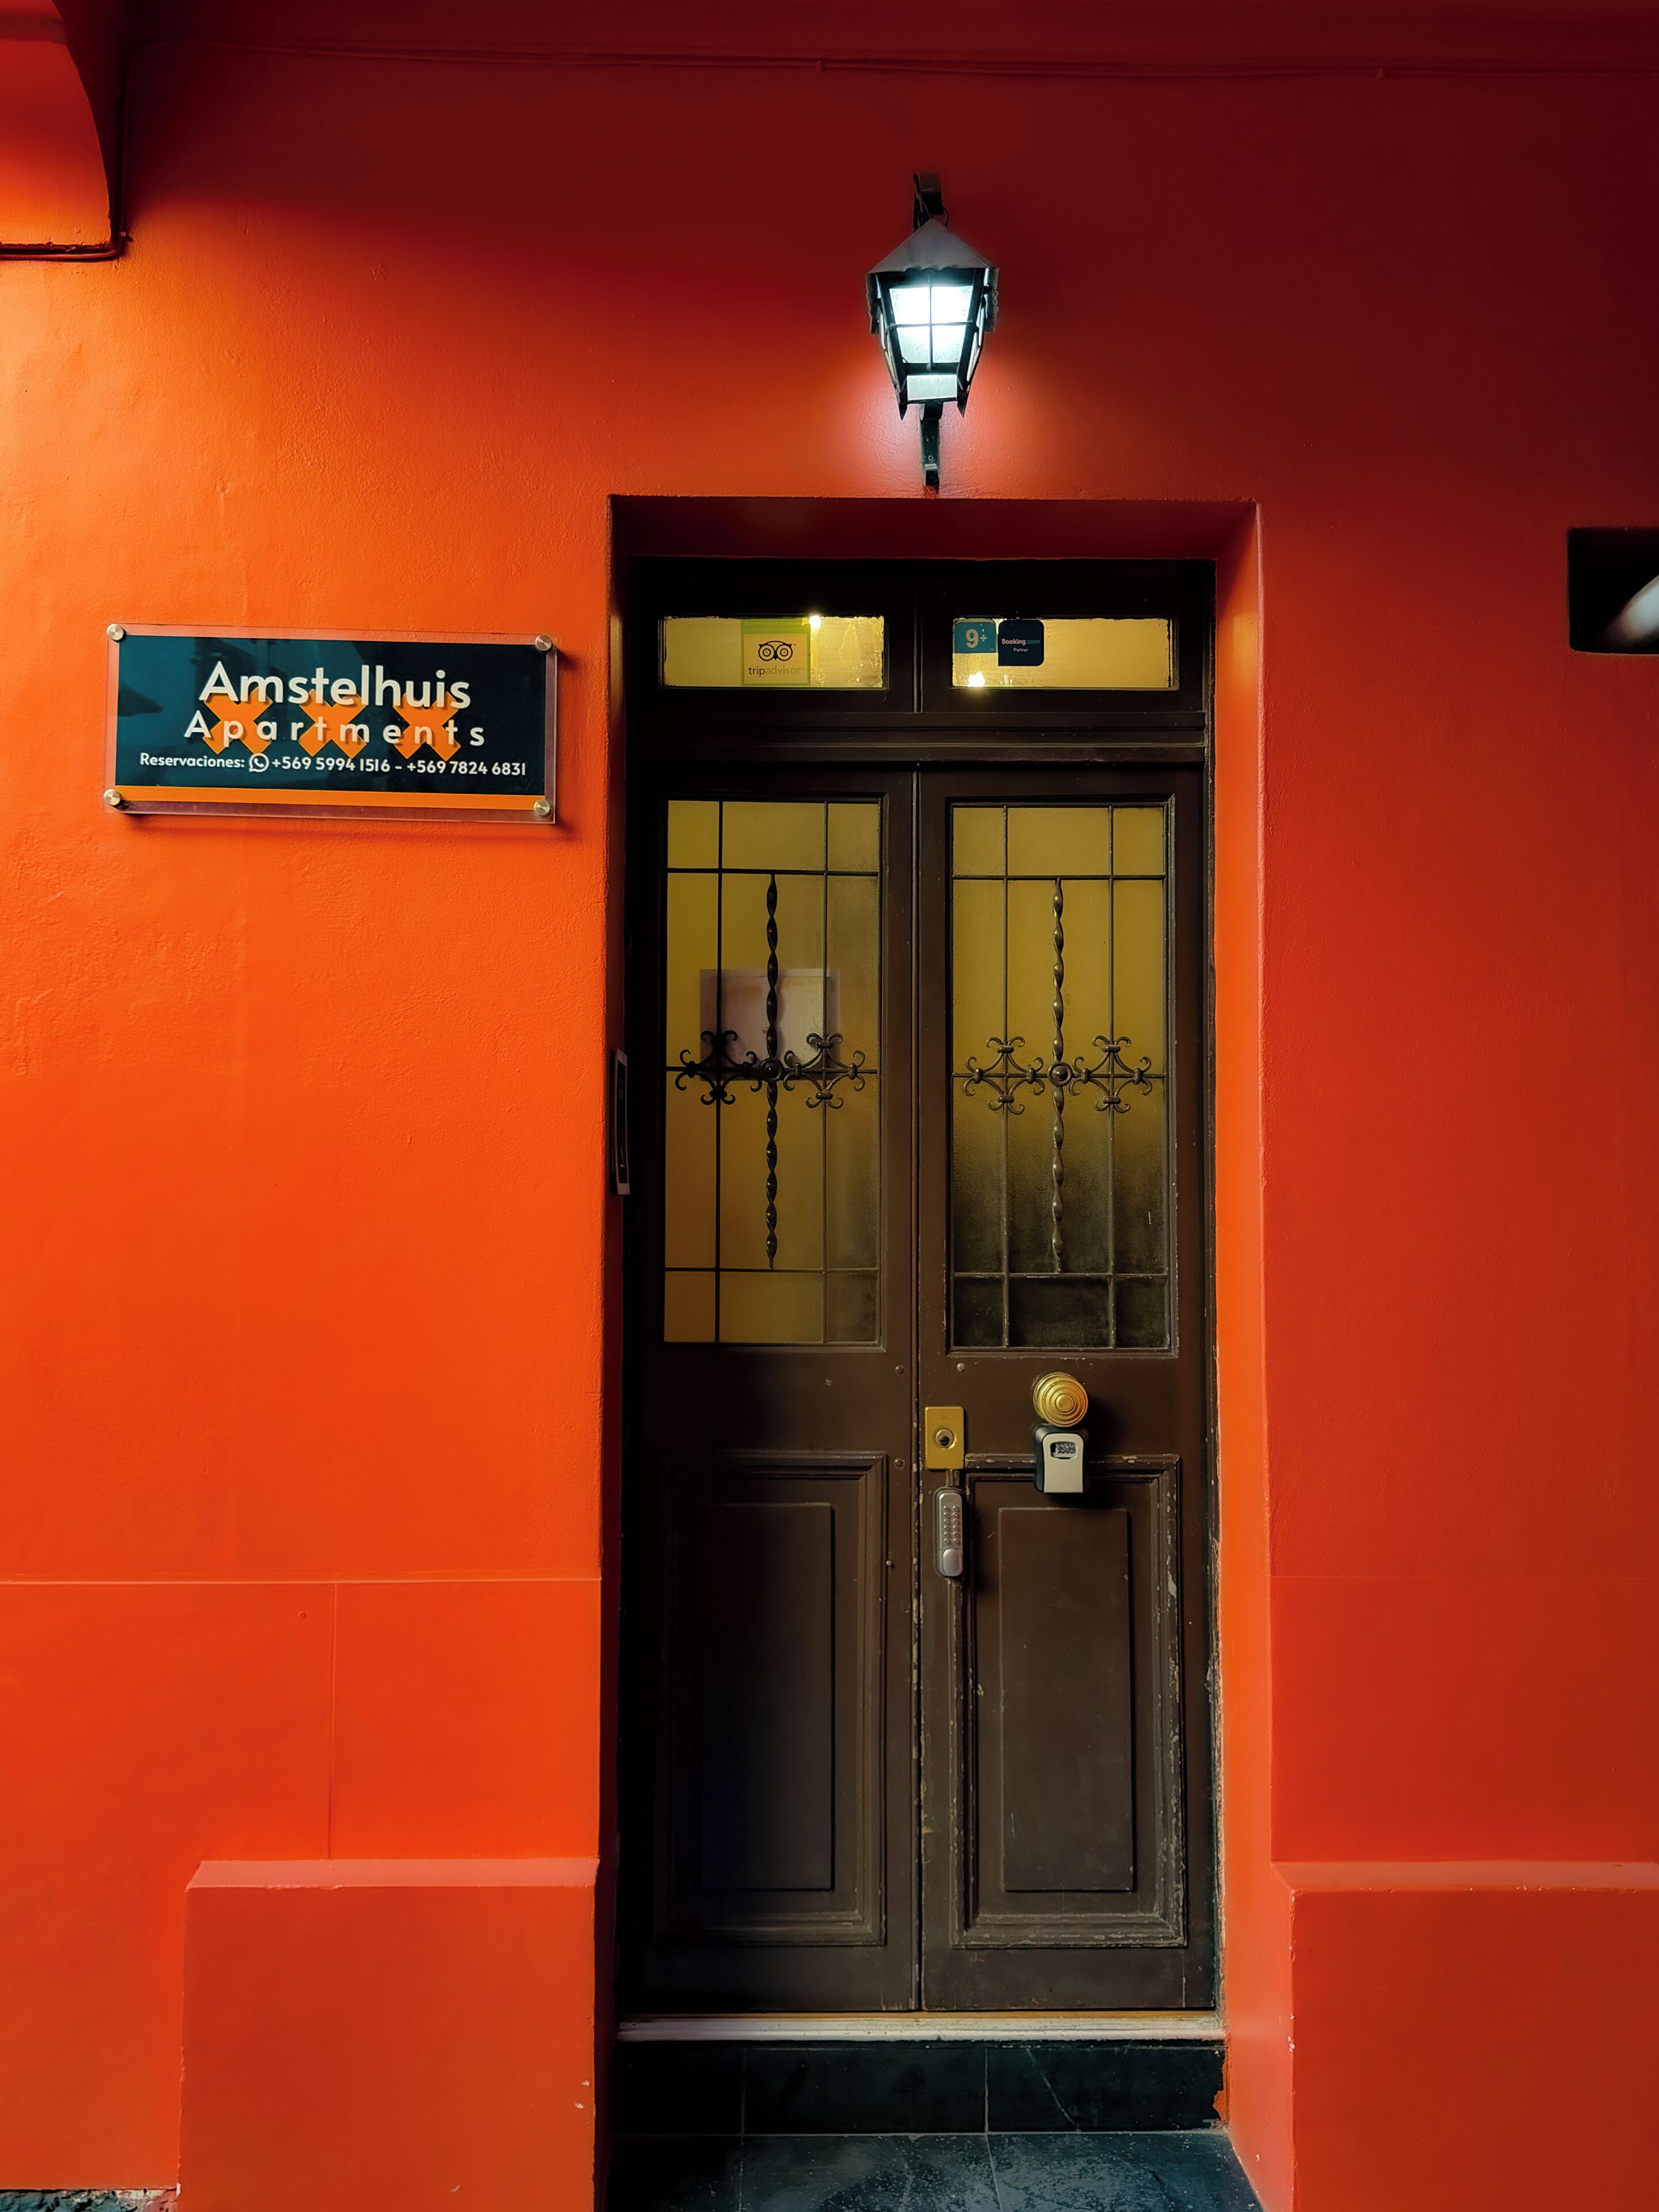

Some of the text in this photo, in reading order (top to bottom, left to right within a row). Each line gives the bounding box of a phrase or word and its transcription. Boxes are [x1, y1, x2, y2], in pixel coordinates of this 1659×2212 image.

[965, 628, 987, 648] 9+
[748, 665, 801, 677] tripadvisor
[198, 660, 471, 709] Amstelhuis
[184, 710, 486, 748] Apartments
[139, 752, 245, 768] Reservaciones:
[272, 756, 312, 770] +569
[315, 757, 356, 771] 5994
[359, 758, 391, 772] 1516
[406, 760, 446, 774] +569
[449, 761, 488, 775] 7824
[491, 762, 526, 776] 6831
